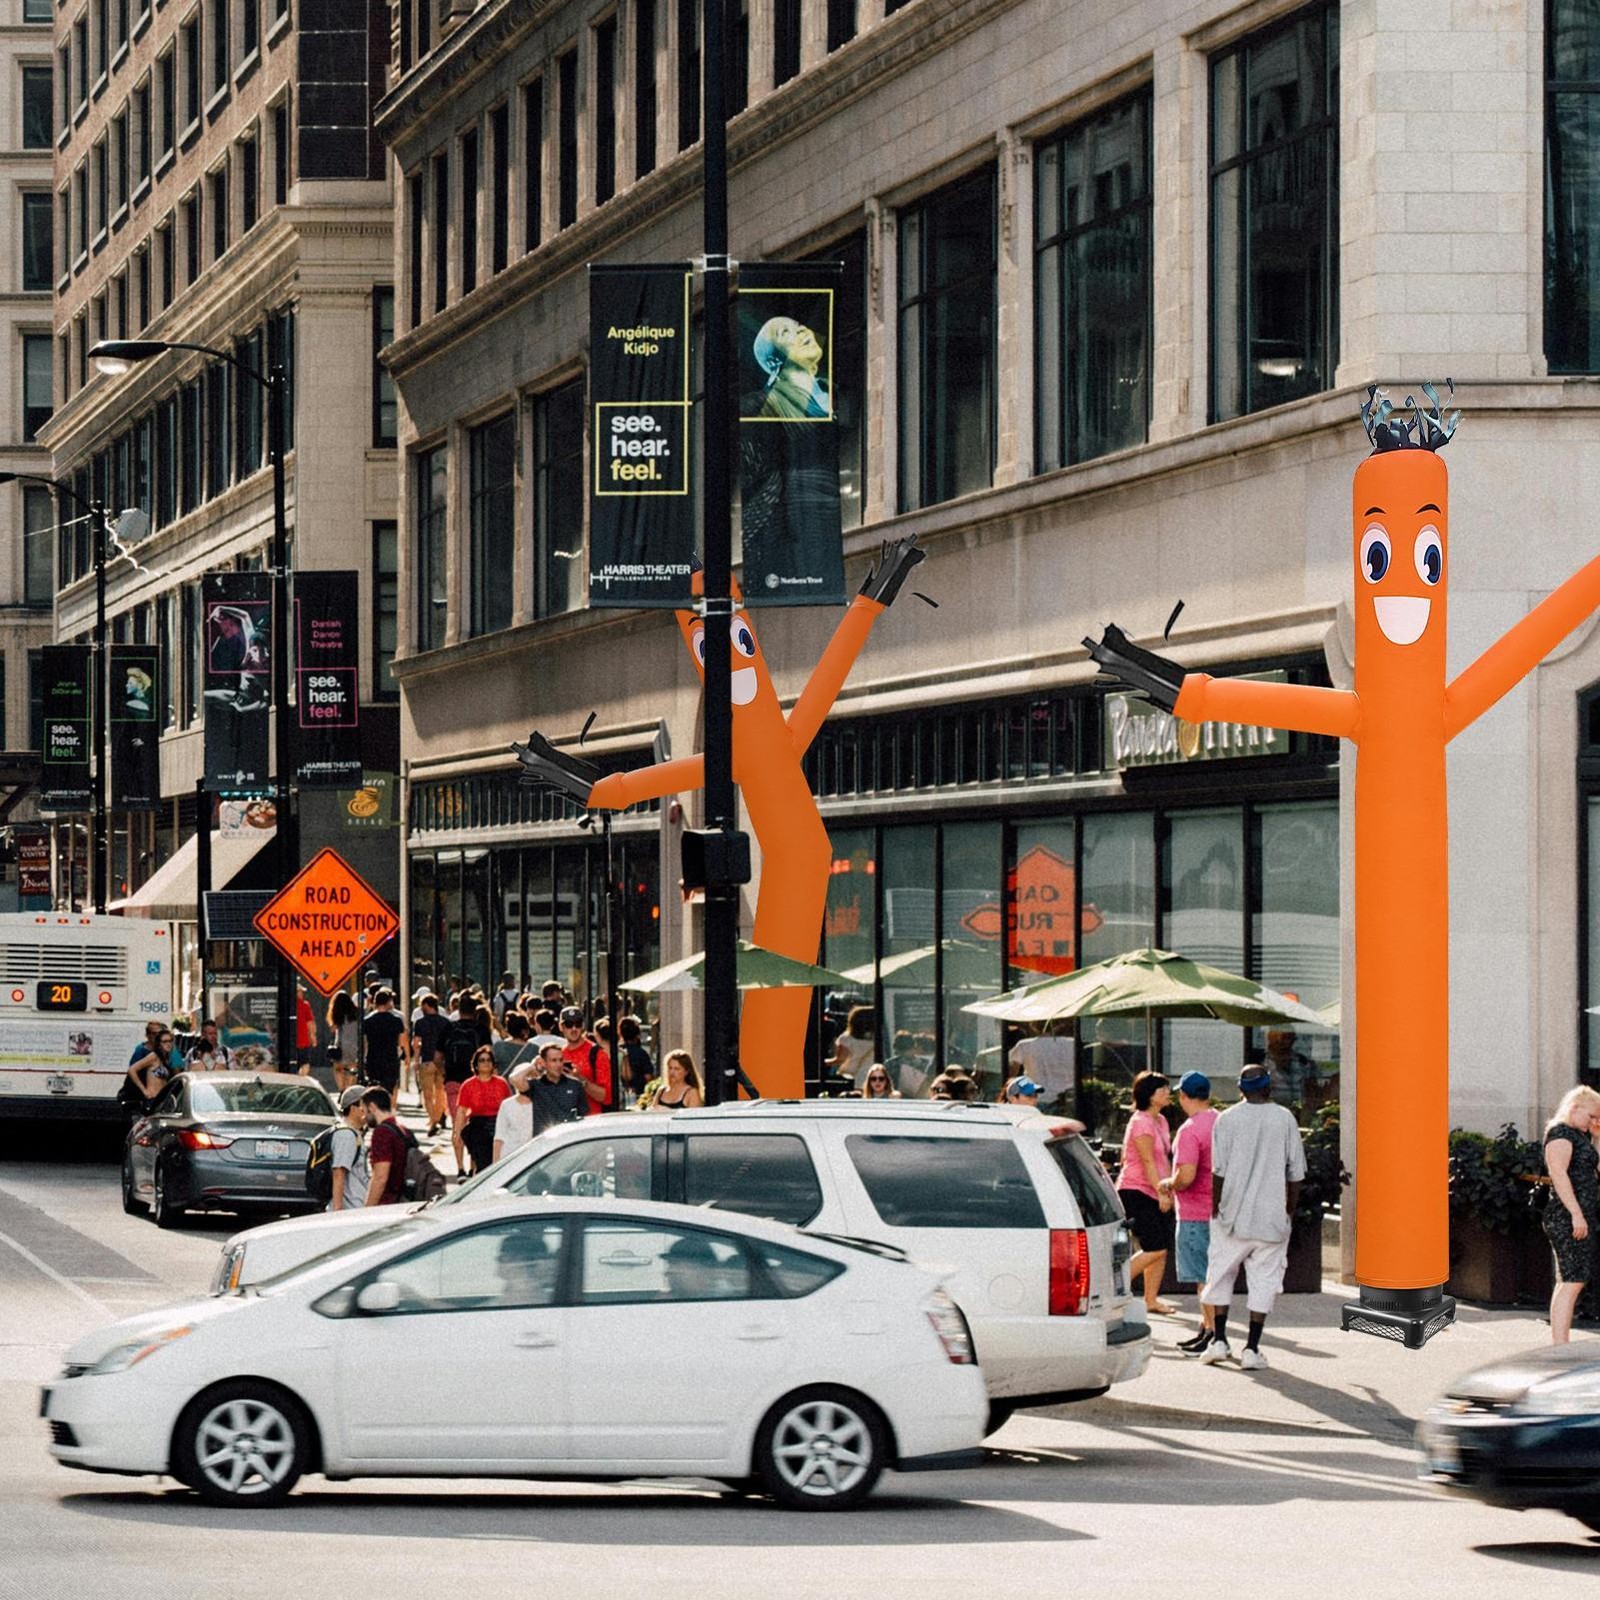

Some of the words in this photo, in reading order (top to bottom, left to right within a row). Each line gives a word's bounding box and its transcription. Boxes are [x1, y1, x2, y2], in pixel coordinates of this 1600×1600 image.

[607, 325, 675, 340] Angélique
[624, 342, 659, 356] Kidjo
[611, 415, 662, 432] see.
[611, 435, 670, 457] hear.
[610, 459, 662, 480] feel.
[604, 564, 644, 575] HARRIS
[645, 564, 691, 575] THEATER
[311, 620, 342, 628] Danish
[312, 630, 340, 639] Dance
[310, 640, 343, 649] Theatre
[308, 676, 341, 688] see.
[308, 689, 347, 703] hear.
[308, 704, 342, 719] feel.
[51, 724, 77, 734] see.
[51, 735, 81, 746] hear.
[51, 746, 76, 757] feel.
[305, 887, 351, 904] ROAD
[267, 913, 388, 931] CONSTRUCTION
[300, 941, 356, 957] AHEAD
[51, 985, 71, 1003] 20
[139, 1002, 168, 1013] 1986
